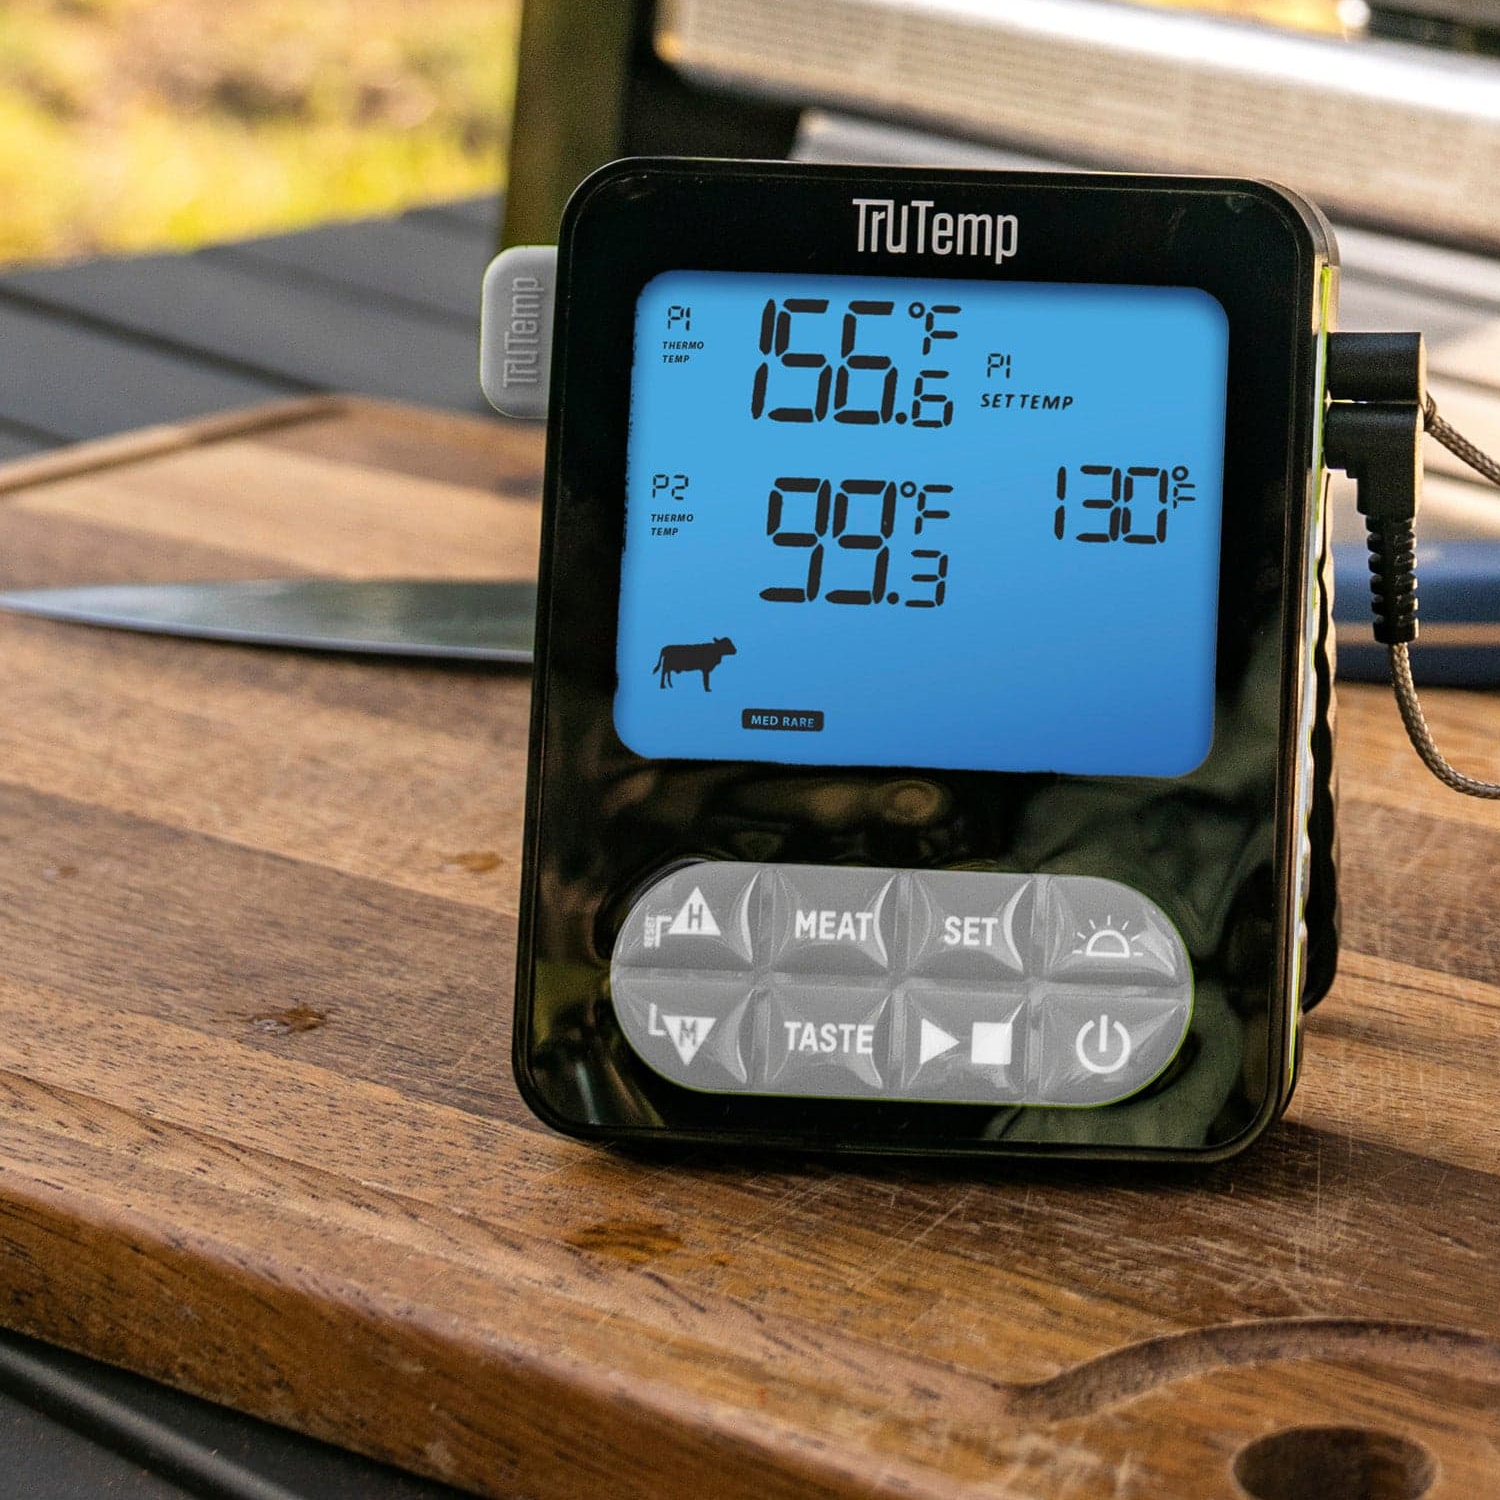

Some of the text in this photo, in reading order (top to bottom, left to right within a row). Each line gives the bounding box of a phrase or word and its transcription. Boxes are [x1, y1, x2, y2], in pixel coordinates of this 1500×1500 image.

[667, 305, 691, 331] P1
[662, 340, 705, 350] THERMO
[662, 354, 690, 364] TEMP
[986, 352, 1011, 379] P1
[980, 393, 1073, 411] SET TEMP
[652, 474, 689, 501] P2
[650, 513, 695, 523] THERMO
[650, 527, 679, 537] TEMP
[751, 714, 816, 729] MED RARE
[795, 909, 873, 942] MEAT
[944, 915, 999, 947] SET
[783, 1020, 875, 1055] TASTE
